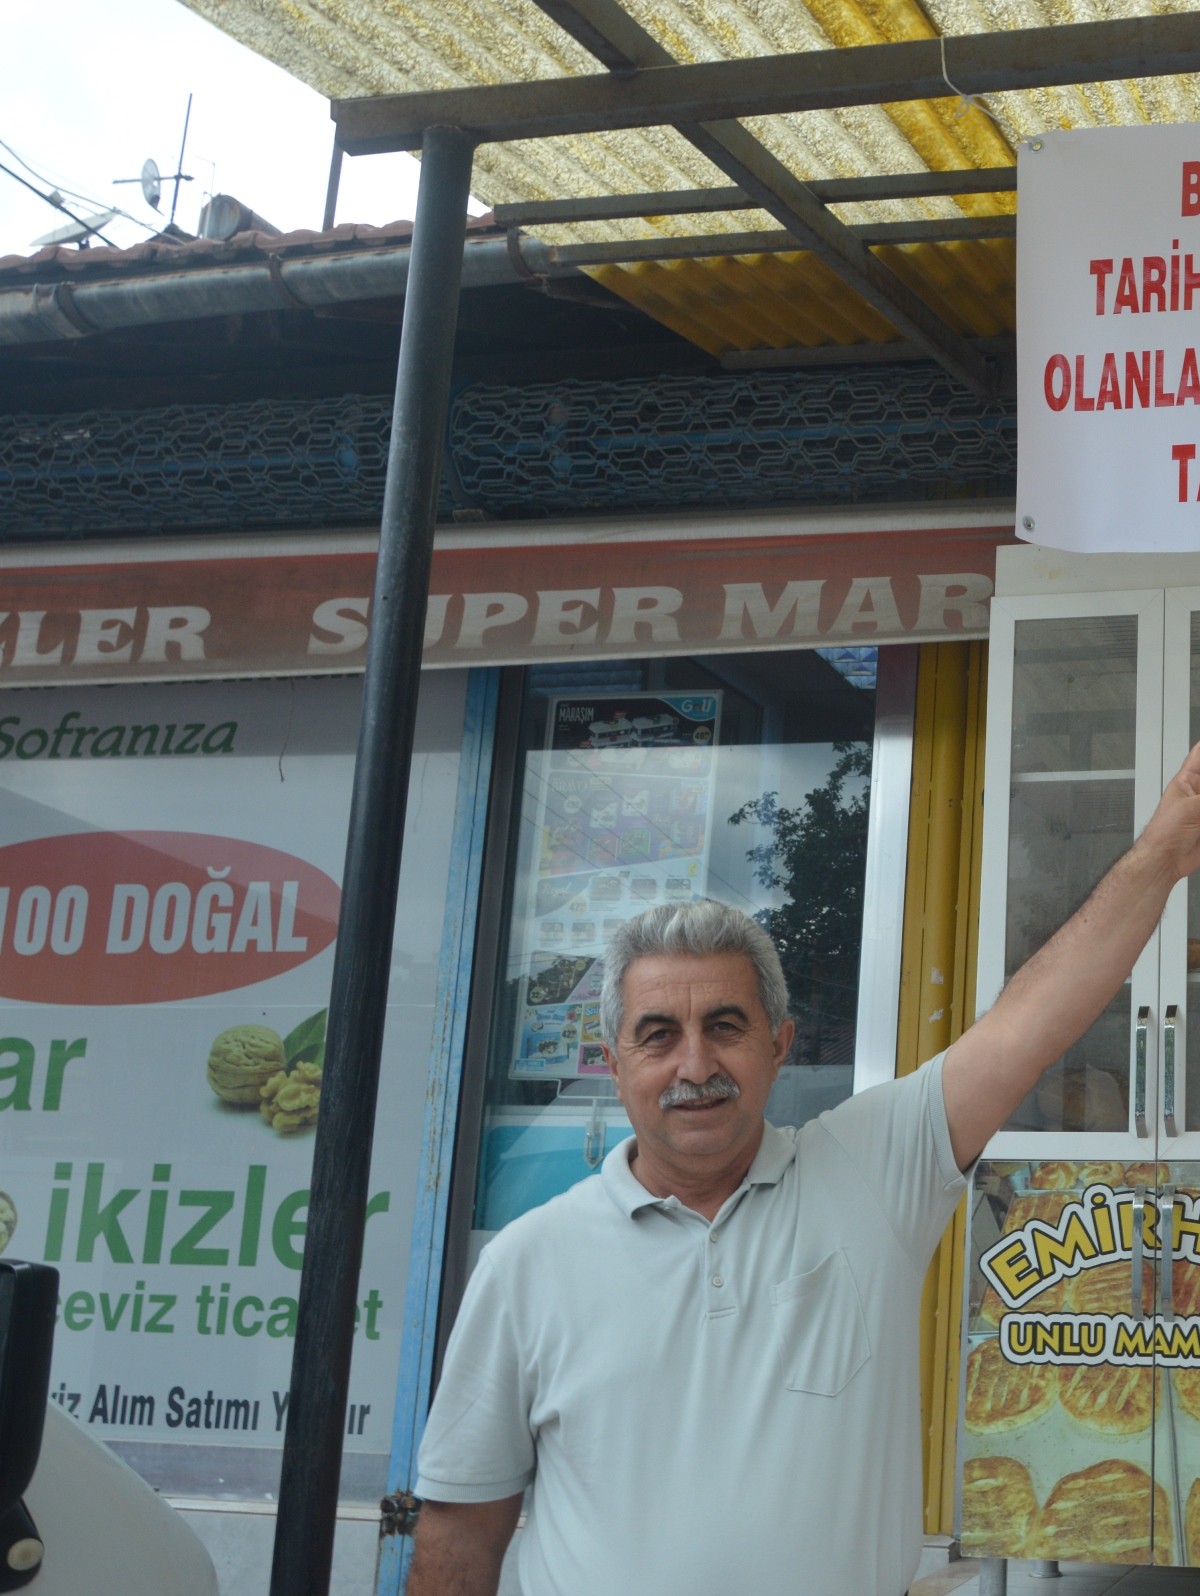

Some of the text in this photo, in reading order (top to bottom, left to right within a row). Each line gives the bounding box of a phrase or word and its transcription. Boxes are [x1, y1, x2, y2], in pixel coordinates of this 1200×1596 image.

[0, 712, 238, 760] Sofranıza
[106, 866, 308, 955] DOĞAL
[54, 1280, 177, 1334] eviz
[1008, 1322, 1106, 1357] UNLU
[88, 1384, 155, 1426] Alım
[165, 1386, 260, 1431] Satımı
